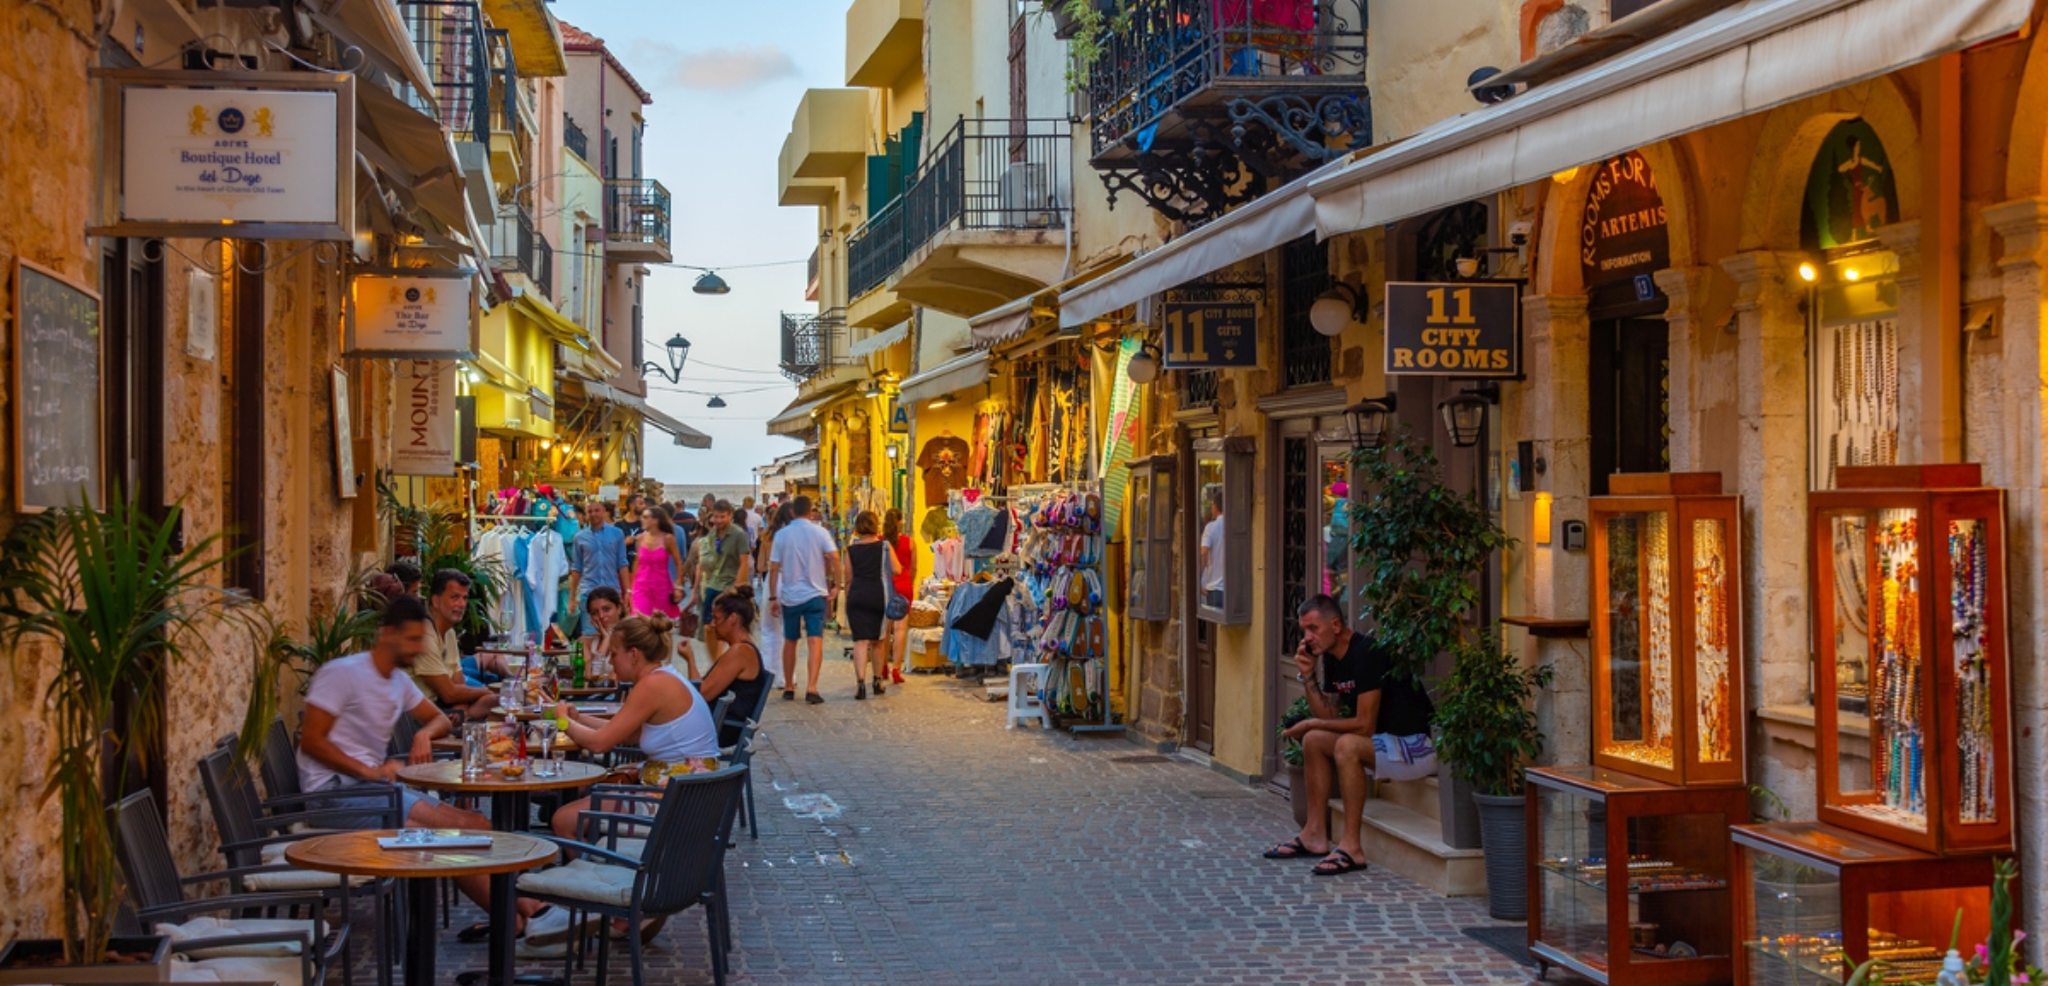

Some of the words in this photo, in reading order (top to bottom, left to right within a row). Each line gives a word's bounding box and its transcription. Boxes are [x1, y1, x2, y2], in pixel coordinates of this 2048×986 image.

[181, 150, 241, 168] Boutique
[244, 152, 281, 165] Hotel
[199, 170, 217, 183] del
[221, 166, 262, 187] Doge
[1583, 172, 1611, 267] ROOMS
[1609, 156, 1646, 187] FOR
[1601, 206, 1667, 239] ARTEMIS
[1601, 251, 1652, 271] INFORMATION
[1637, 280, 1648, 296] 13
[396, 311, 412, 320] The
[414, 311, 430, 320] Bar
[1204, 308, 1223, 319] CITY
[1226, 308, 1254, 319] ROOMS
[1426, 287, 1476, 324] 11
[1167, 309, 1209, 362] 11
[1217, 325, 1242, 337] GIFTS
[1421, 328, 1481, 347] CITY
[1393, 347, 1509, 369] ROOMS
[411, 357, 430, 447] MOUNT
